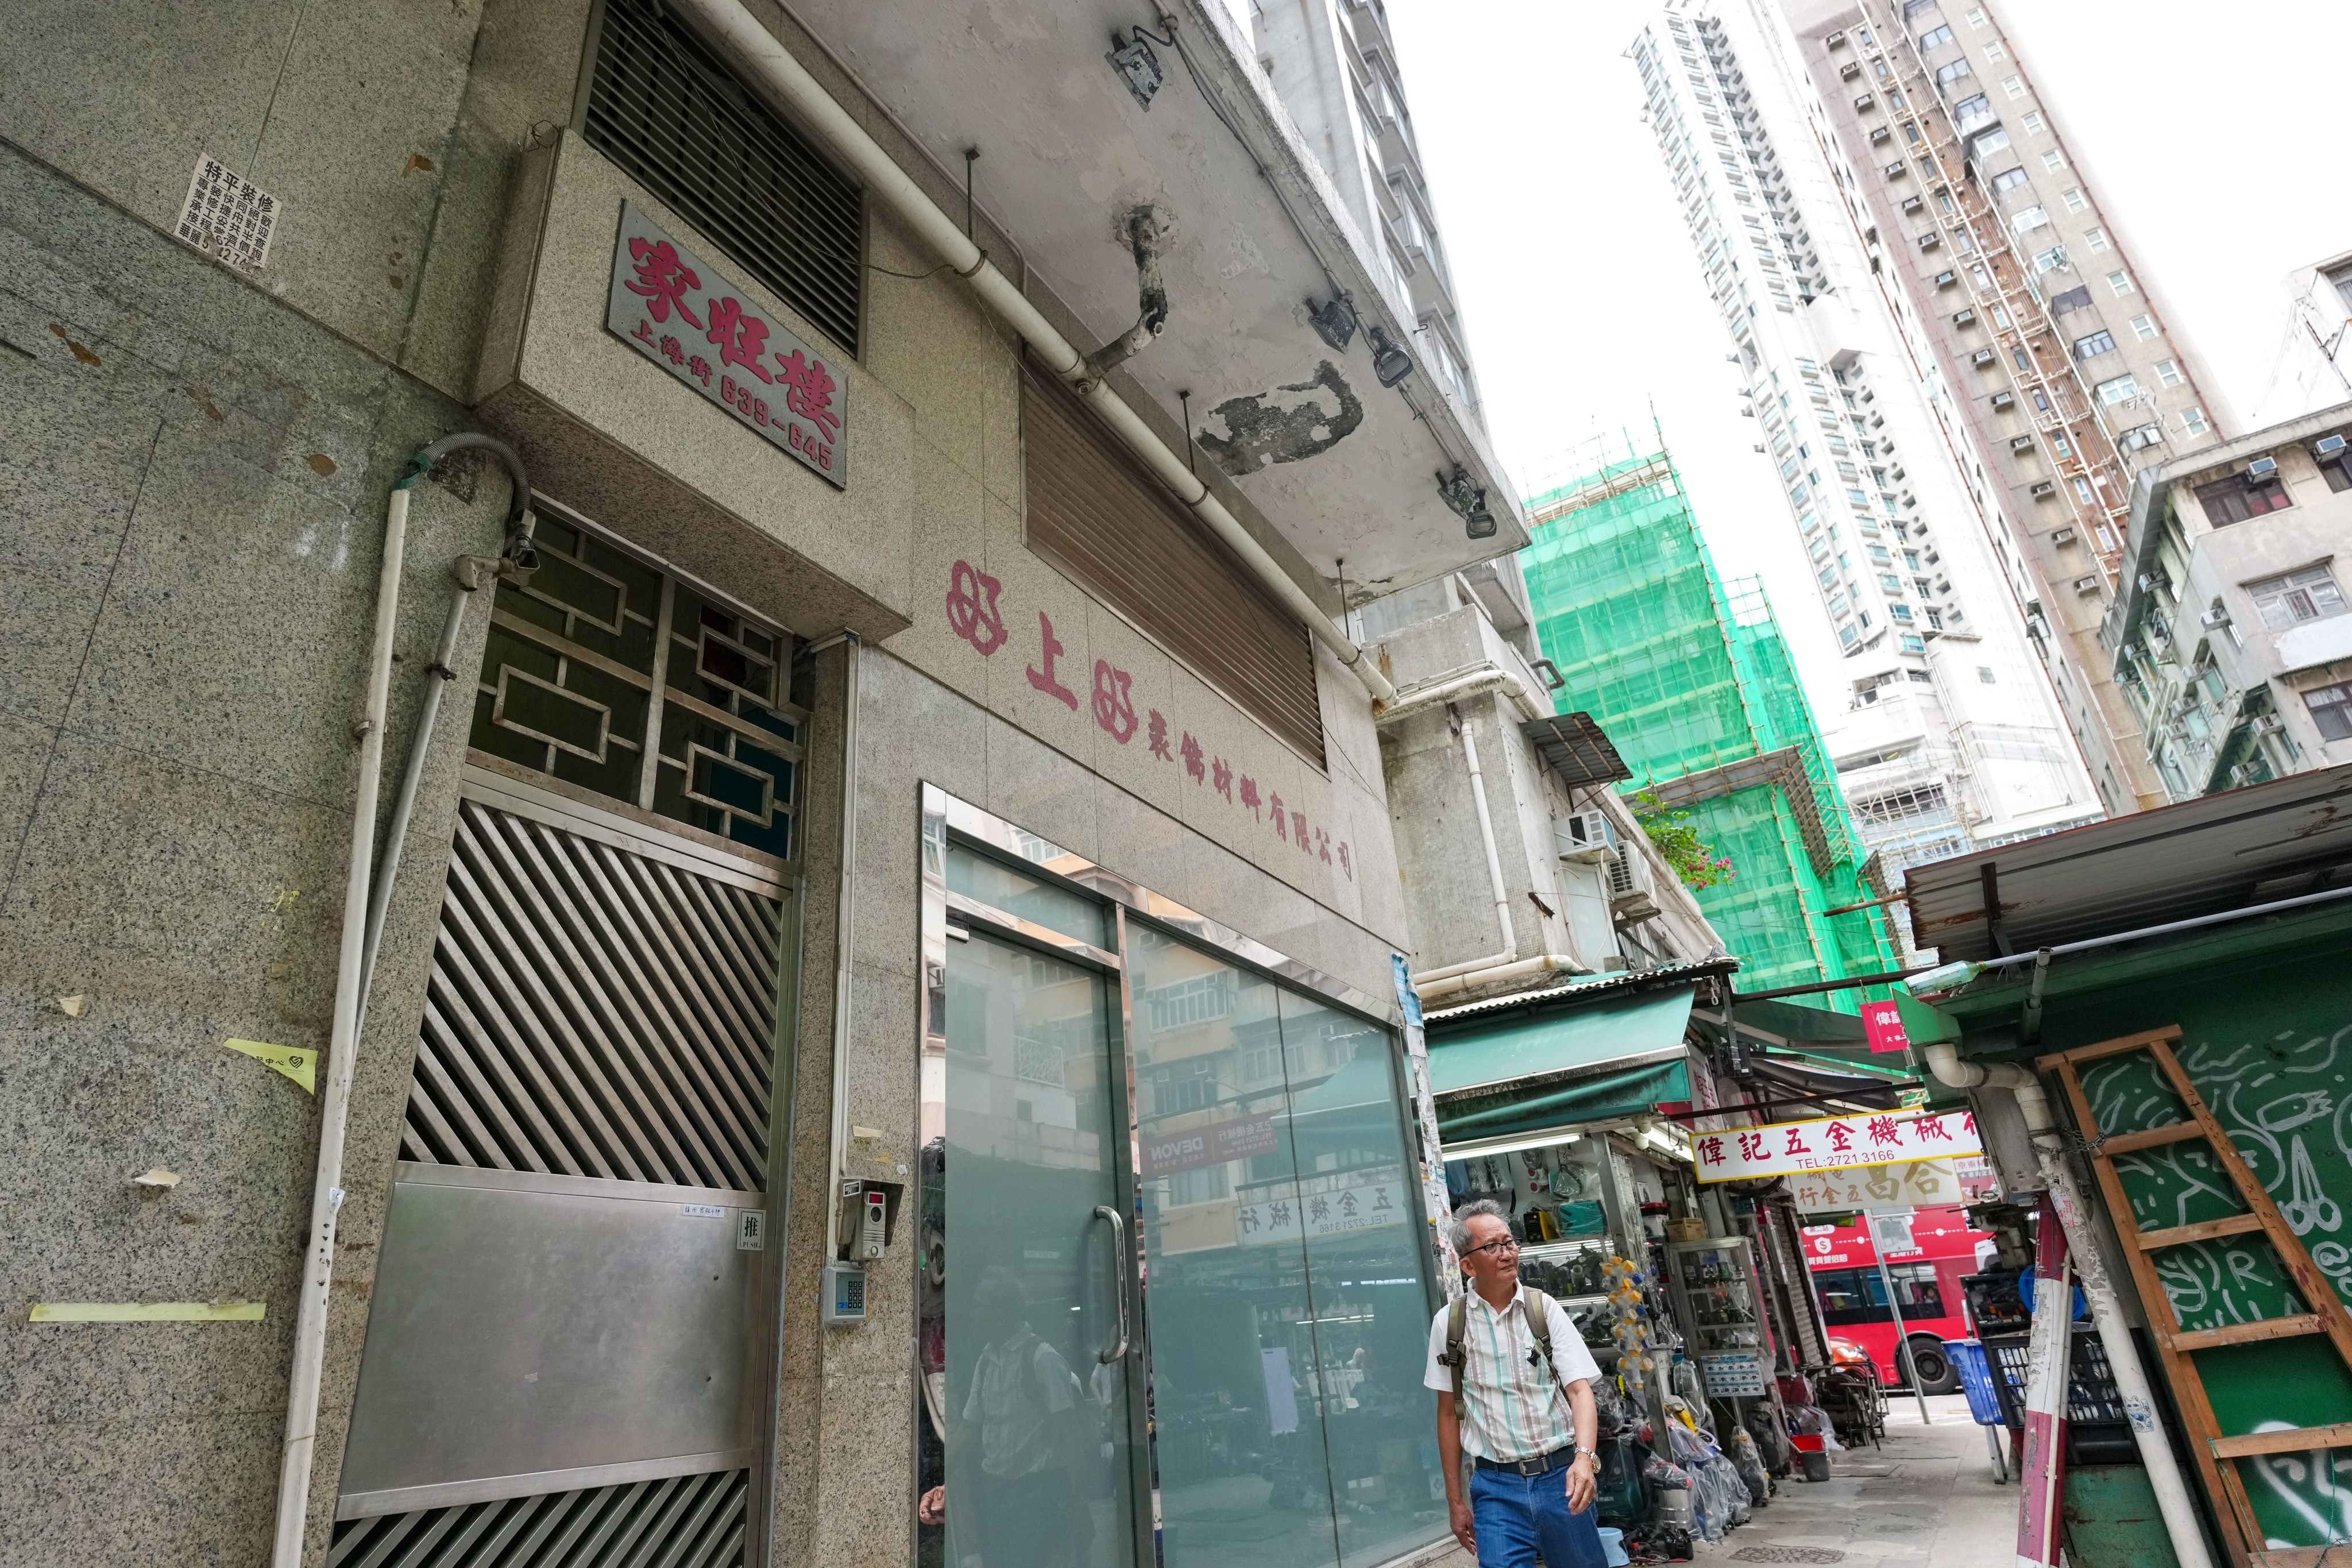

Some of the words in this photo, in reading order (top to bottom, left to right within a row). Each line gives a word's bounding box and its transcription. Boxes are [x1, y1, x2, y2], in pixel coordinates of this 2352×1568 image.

[186, 176, 210, 225] 專業承接
[200, 184, 222, 232] 裝修工程
[204, 161, 275, 213] 特平裝修
[179, 222, 202, 246] 華麗
[240, 207, 260, 254] 絕對半價
[252, 214, 272, 261] 歡迎查詢
[624, 237, 841, 445] 家旺樓
[631, 319, 713, 387] 上海街
[721, 375, 832, 470] 639-645
[744, 1216, 759, 1237] 推
